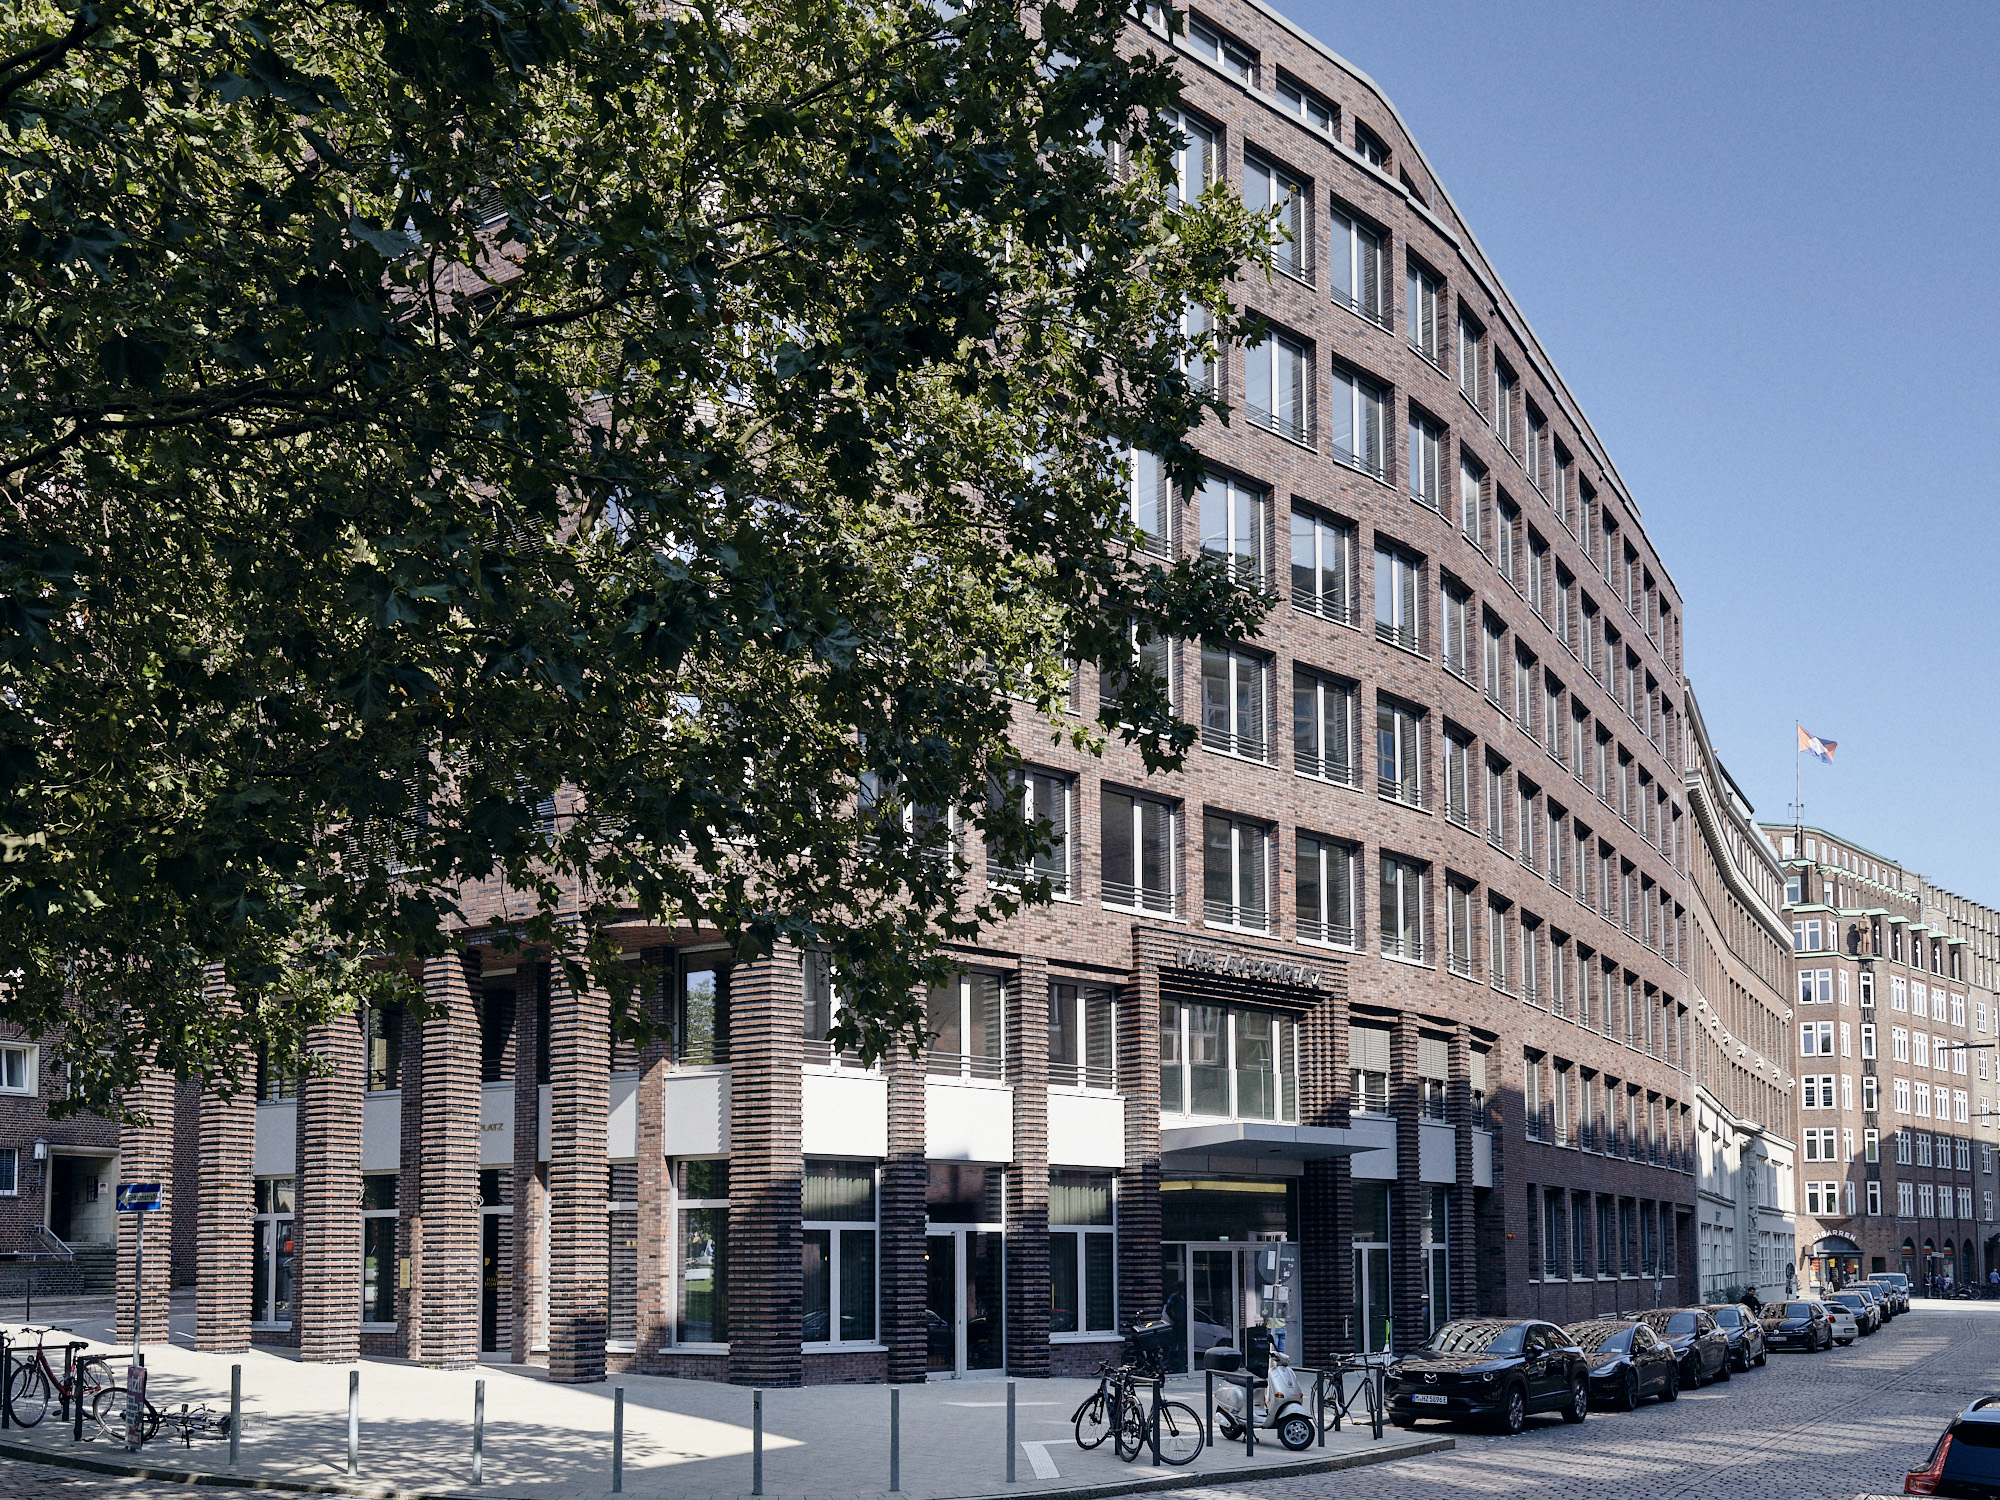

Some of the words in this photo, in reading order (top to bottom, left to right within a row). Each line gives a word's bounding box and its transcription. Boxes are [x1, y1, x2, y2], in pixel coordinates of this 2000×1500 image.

[1177, 948, 1219, 970] HAUS
[1223, 955, 1247, 975] AM
[1252, 959, 1322, 986] DOMPLATZ
